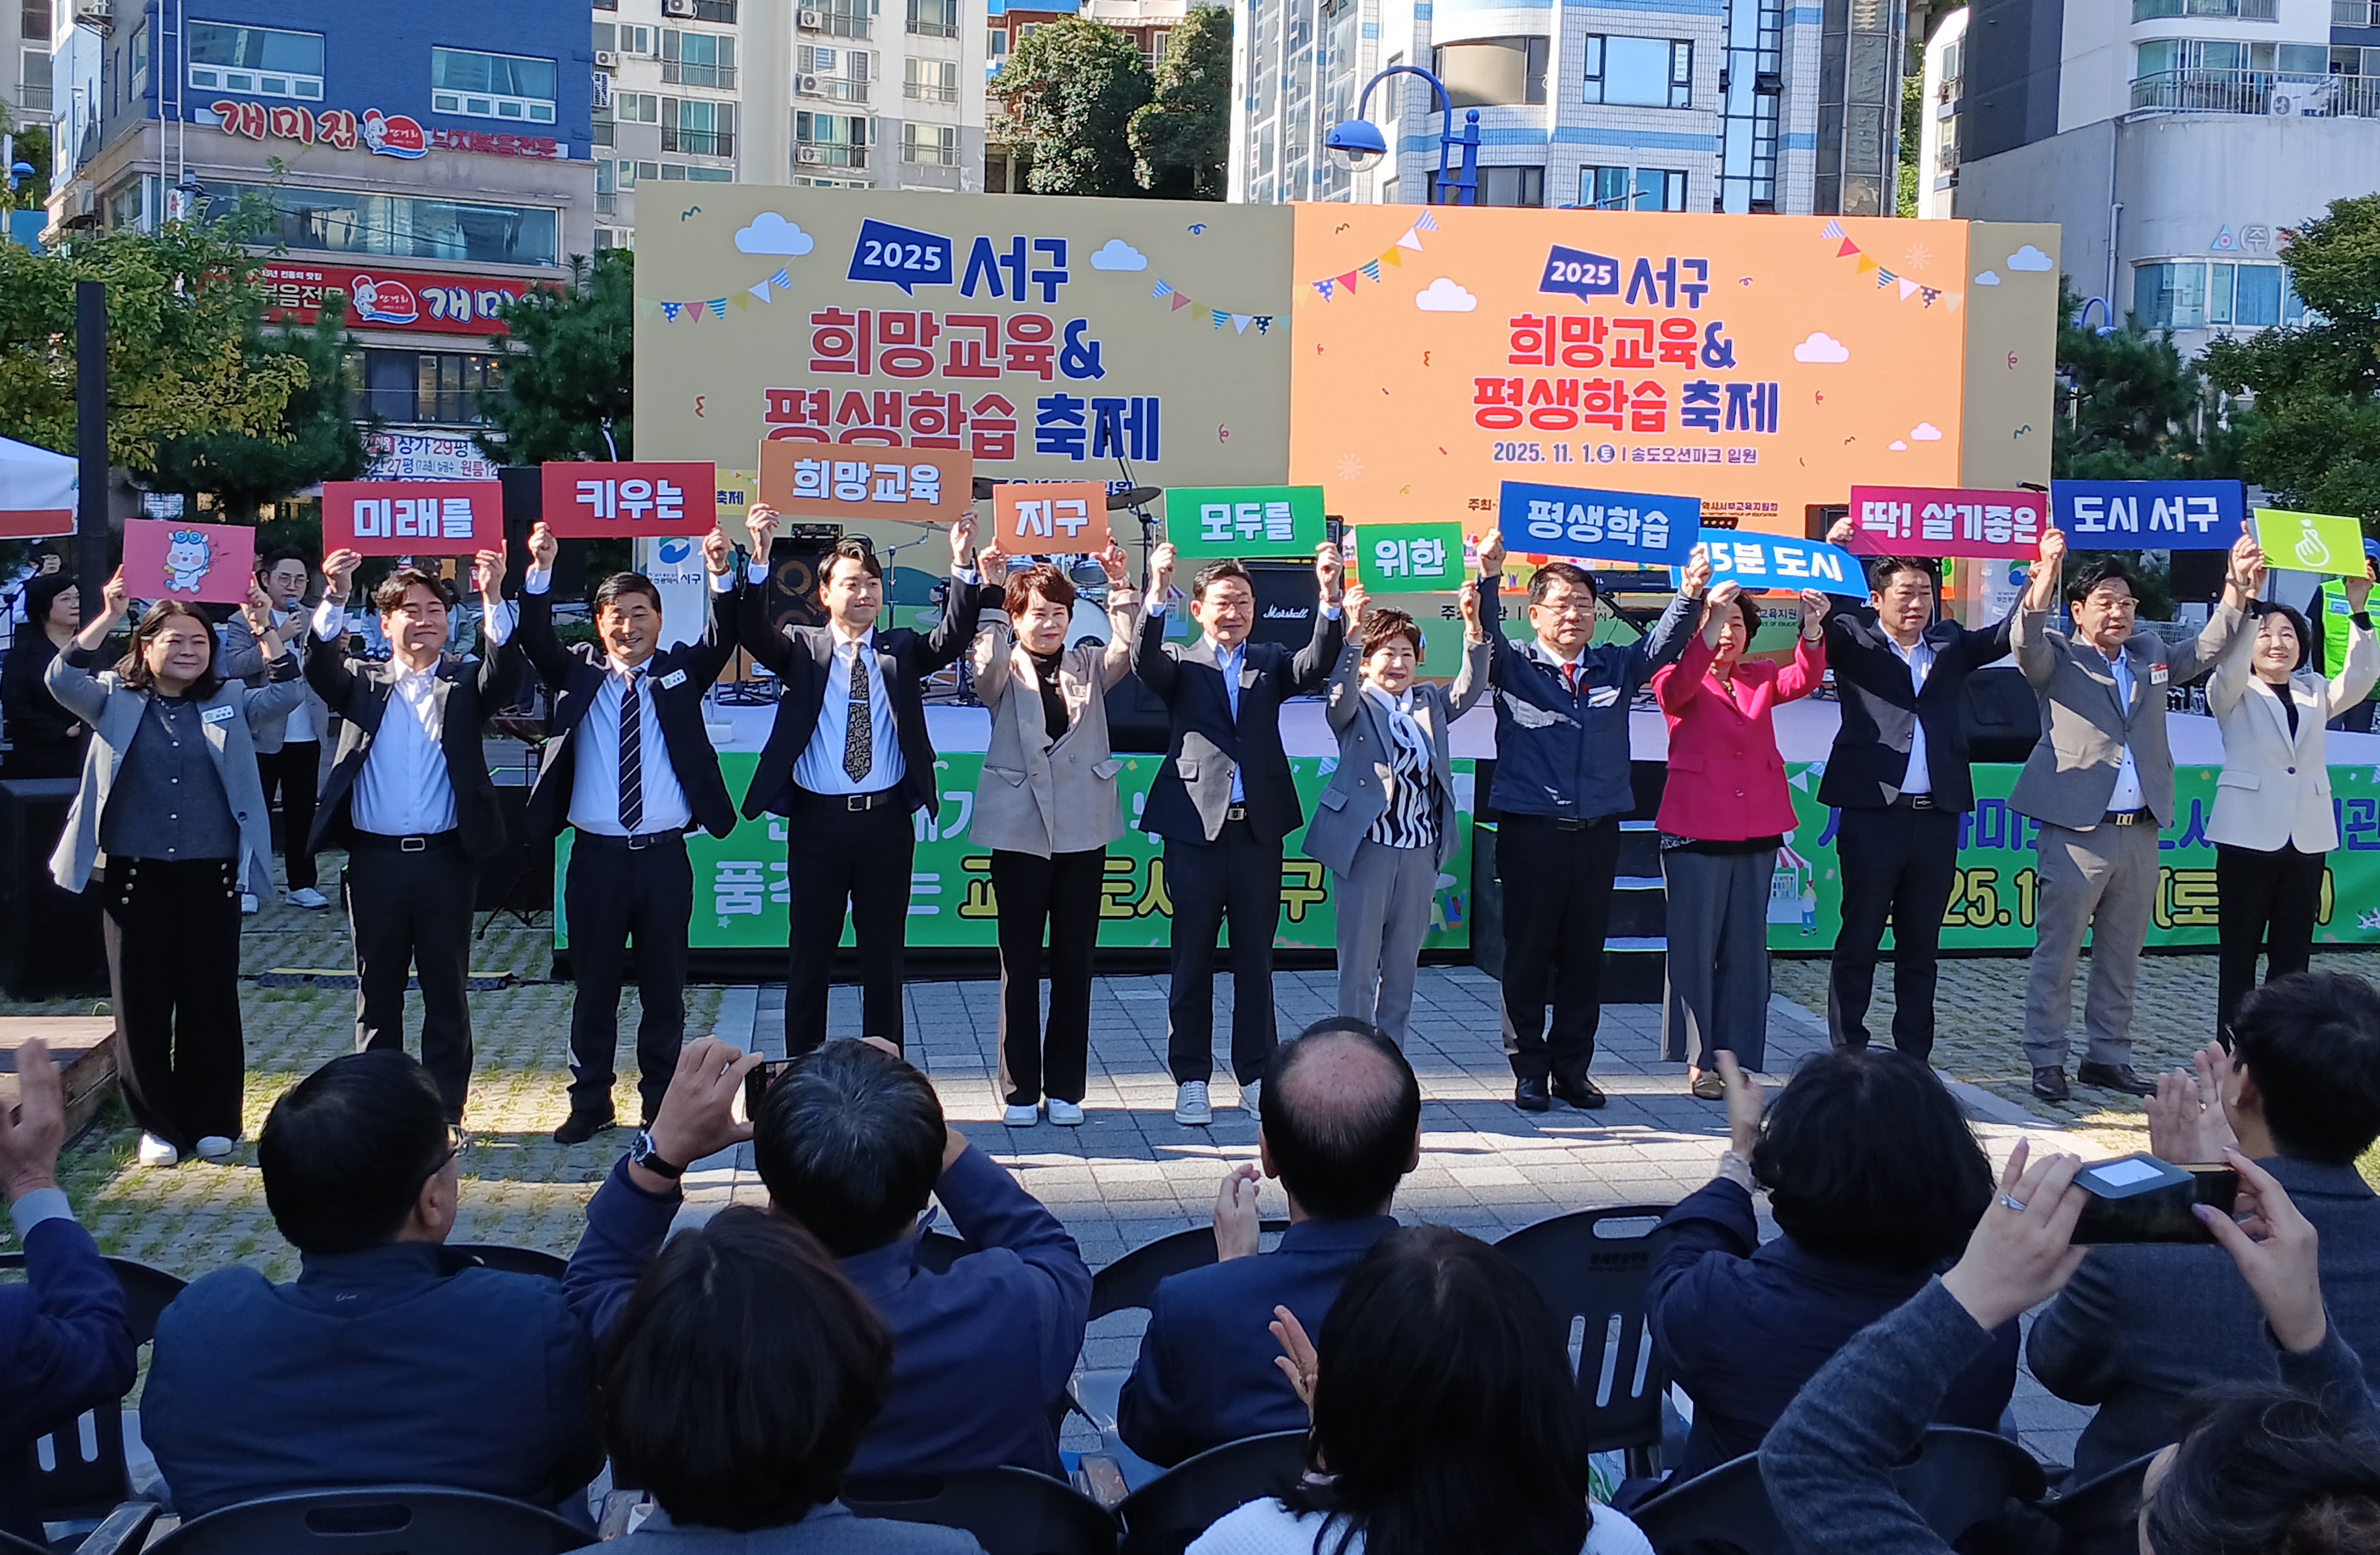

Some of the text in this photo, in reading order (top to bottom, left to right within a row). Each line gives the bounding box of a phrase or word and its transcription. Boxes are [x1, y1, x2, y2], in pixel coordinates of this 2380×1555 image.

[211, 100, 356, 150] 개미집
[432, 122, 558, 160] 낙지볶음전문
[2240, 219, 2273, 252] (주)
[306, 272, 322, 280] 맛집
[864, 236, 1069, 303] 2025 서구
[1551, 257, 1708, 308] 2025 서구
[810, 308, 1105, 380] 희망교육&
[1508, 315, 1736, 371] 희망교육&
[765, 389, 1159, 462] 평생학습 축제
[1474, 378, 1778, 433] 평생학습 축제
[398, 435, 430, 455] 상가
[1494, 442, 1545, 462] 2025.
[1553, 443, 1573, 462] 11.
[1631, 448, 1721, 463] 송도오션파크
[1727, 449, 1757, 464] 일원
[460, 460, 483, 477] 원룸
[792, 458, 940, 505] 희망교육
[576, 479, 683, 519] 키우는
[716, 490, 744, 505] 축제
[2073, 496, 2219, 533] 도시 서구
[353, 498, 473, 539] 미래를
[1015, 499, 1088, 537] 지구
[1200, 502, 1293, 540] 모두를
[1527, 498, 1670, 549] 평생학습
[1861, 501, 2038, 544] 딱! 살기좋은
[1375, 537, 1447, 577] 위한
[1773, 546, 1844, 583] 도시
[1263, 603, 1309, 619] Marshall
